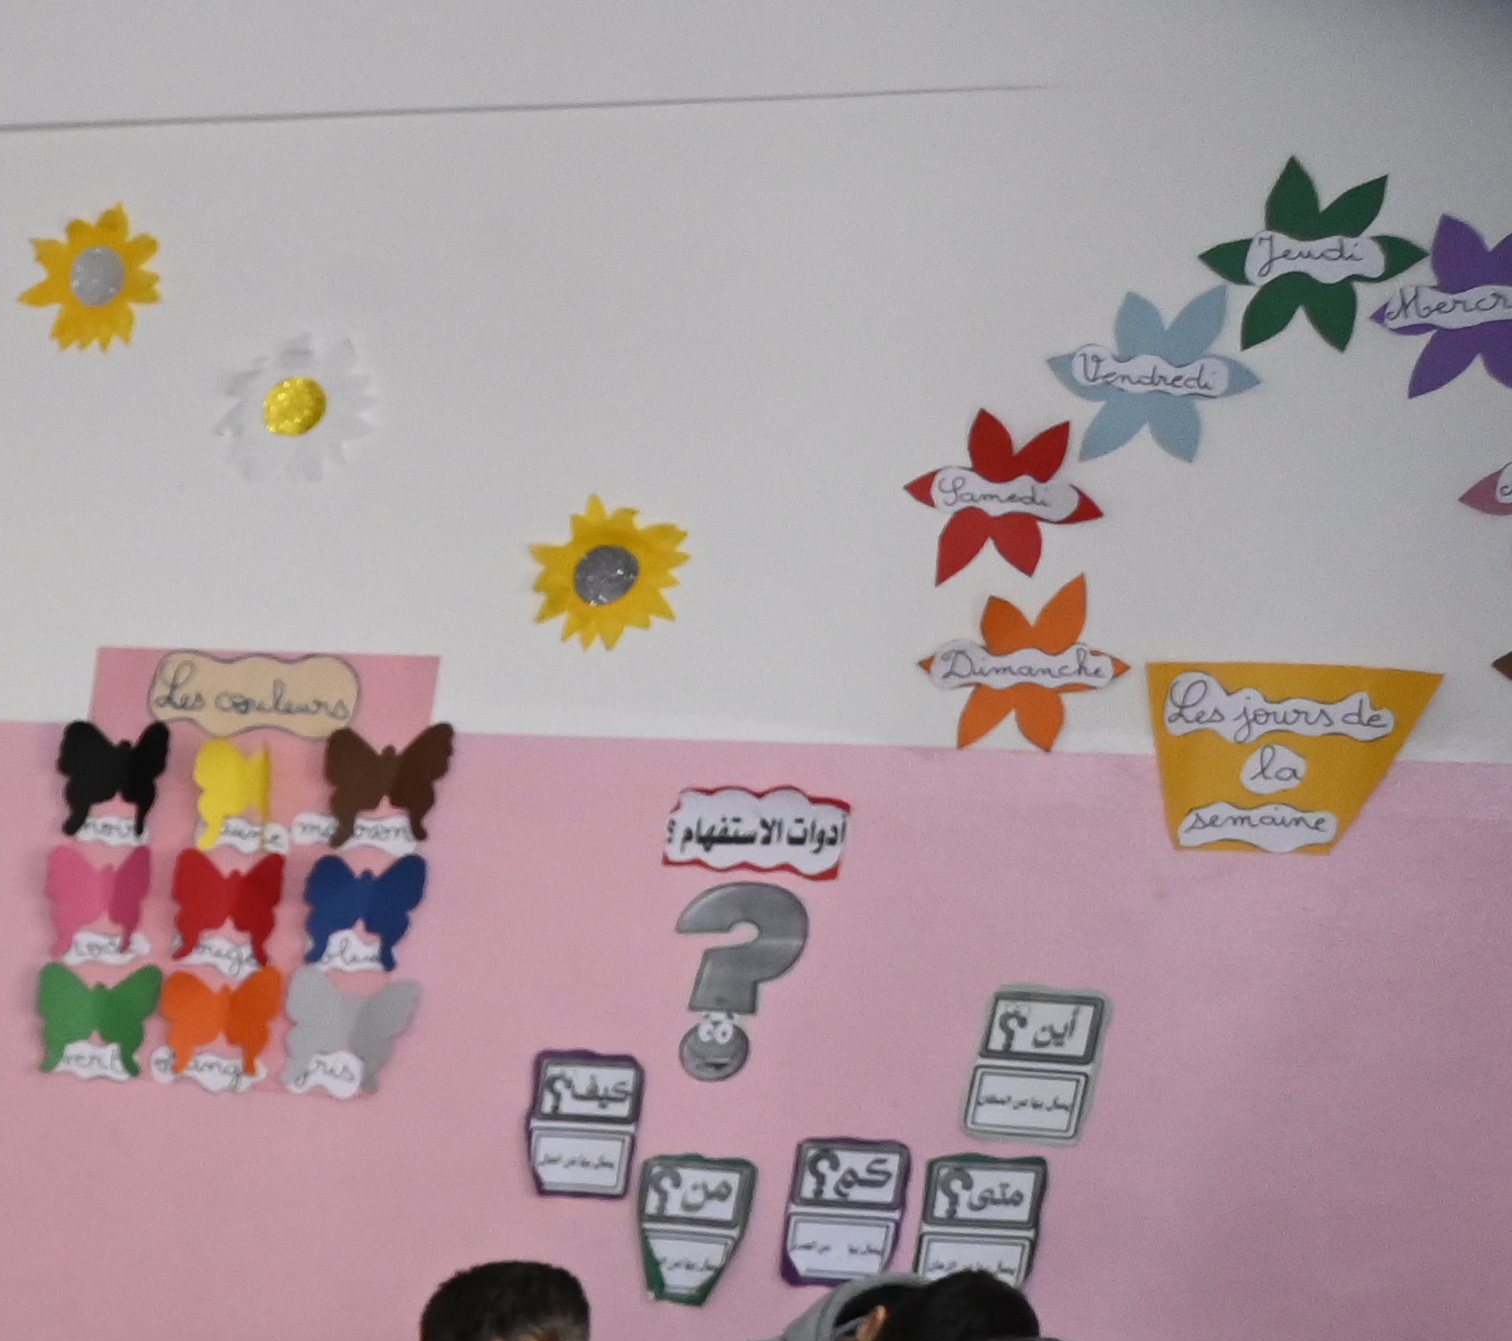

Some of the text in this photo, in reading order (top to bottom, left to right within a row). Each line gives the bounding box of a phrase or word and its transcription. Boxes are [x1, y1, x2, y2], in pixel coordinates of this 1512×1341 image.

[1255, 231, 1365, 280] Jeudi
[1078, 348, 1215, 391] Vendredi
[938, 475, 1053, 509] Samedi
[939, 646, 1106, 681] Dimanche
[153, 658, 207, 713] Les
[1167, 678, 1389, 735] Les jours de
[1248, 743, 1303, 784] la
[785, 812, 847, 854] أدوات
[1184, 805, 1328, 834] semaine
